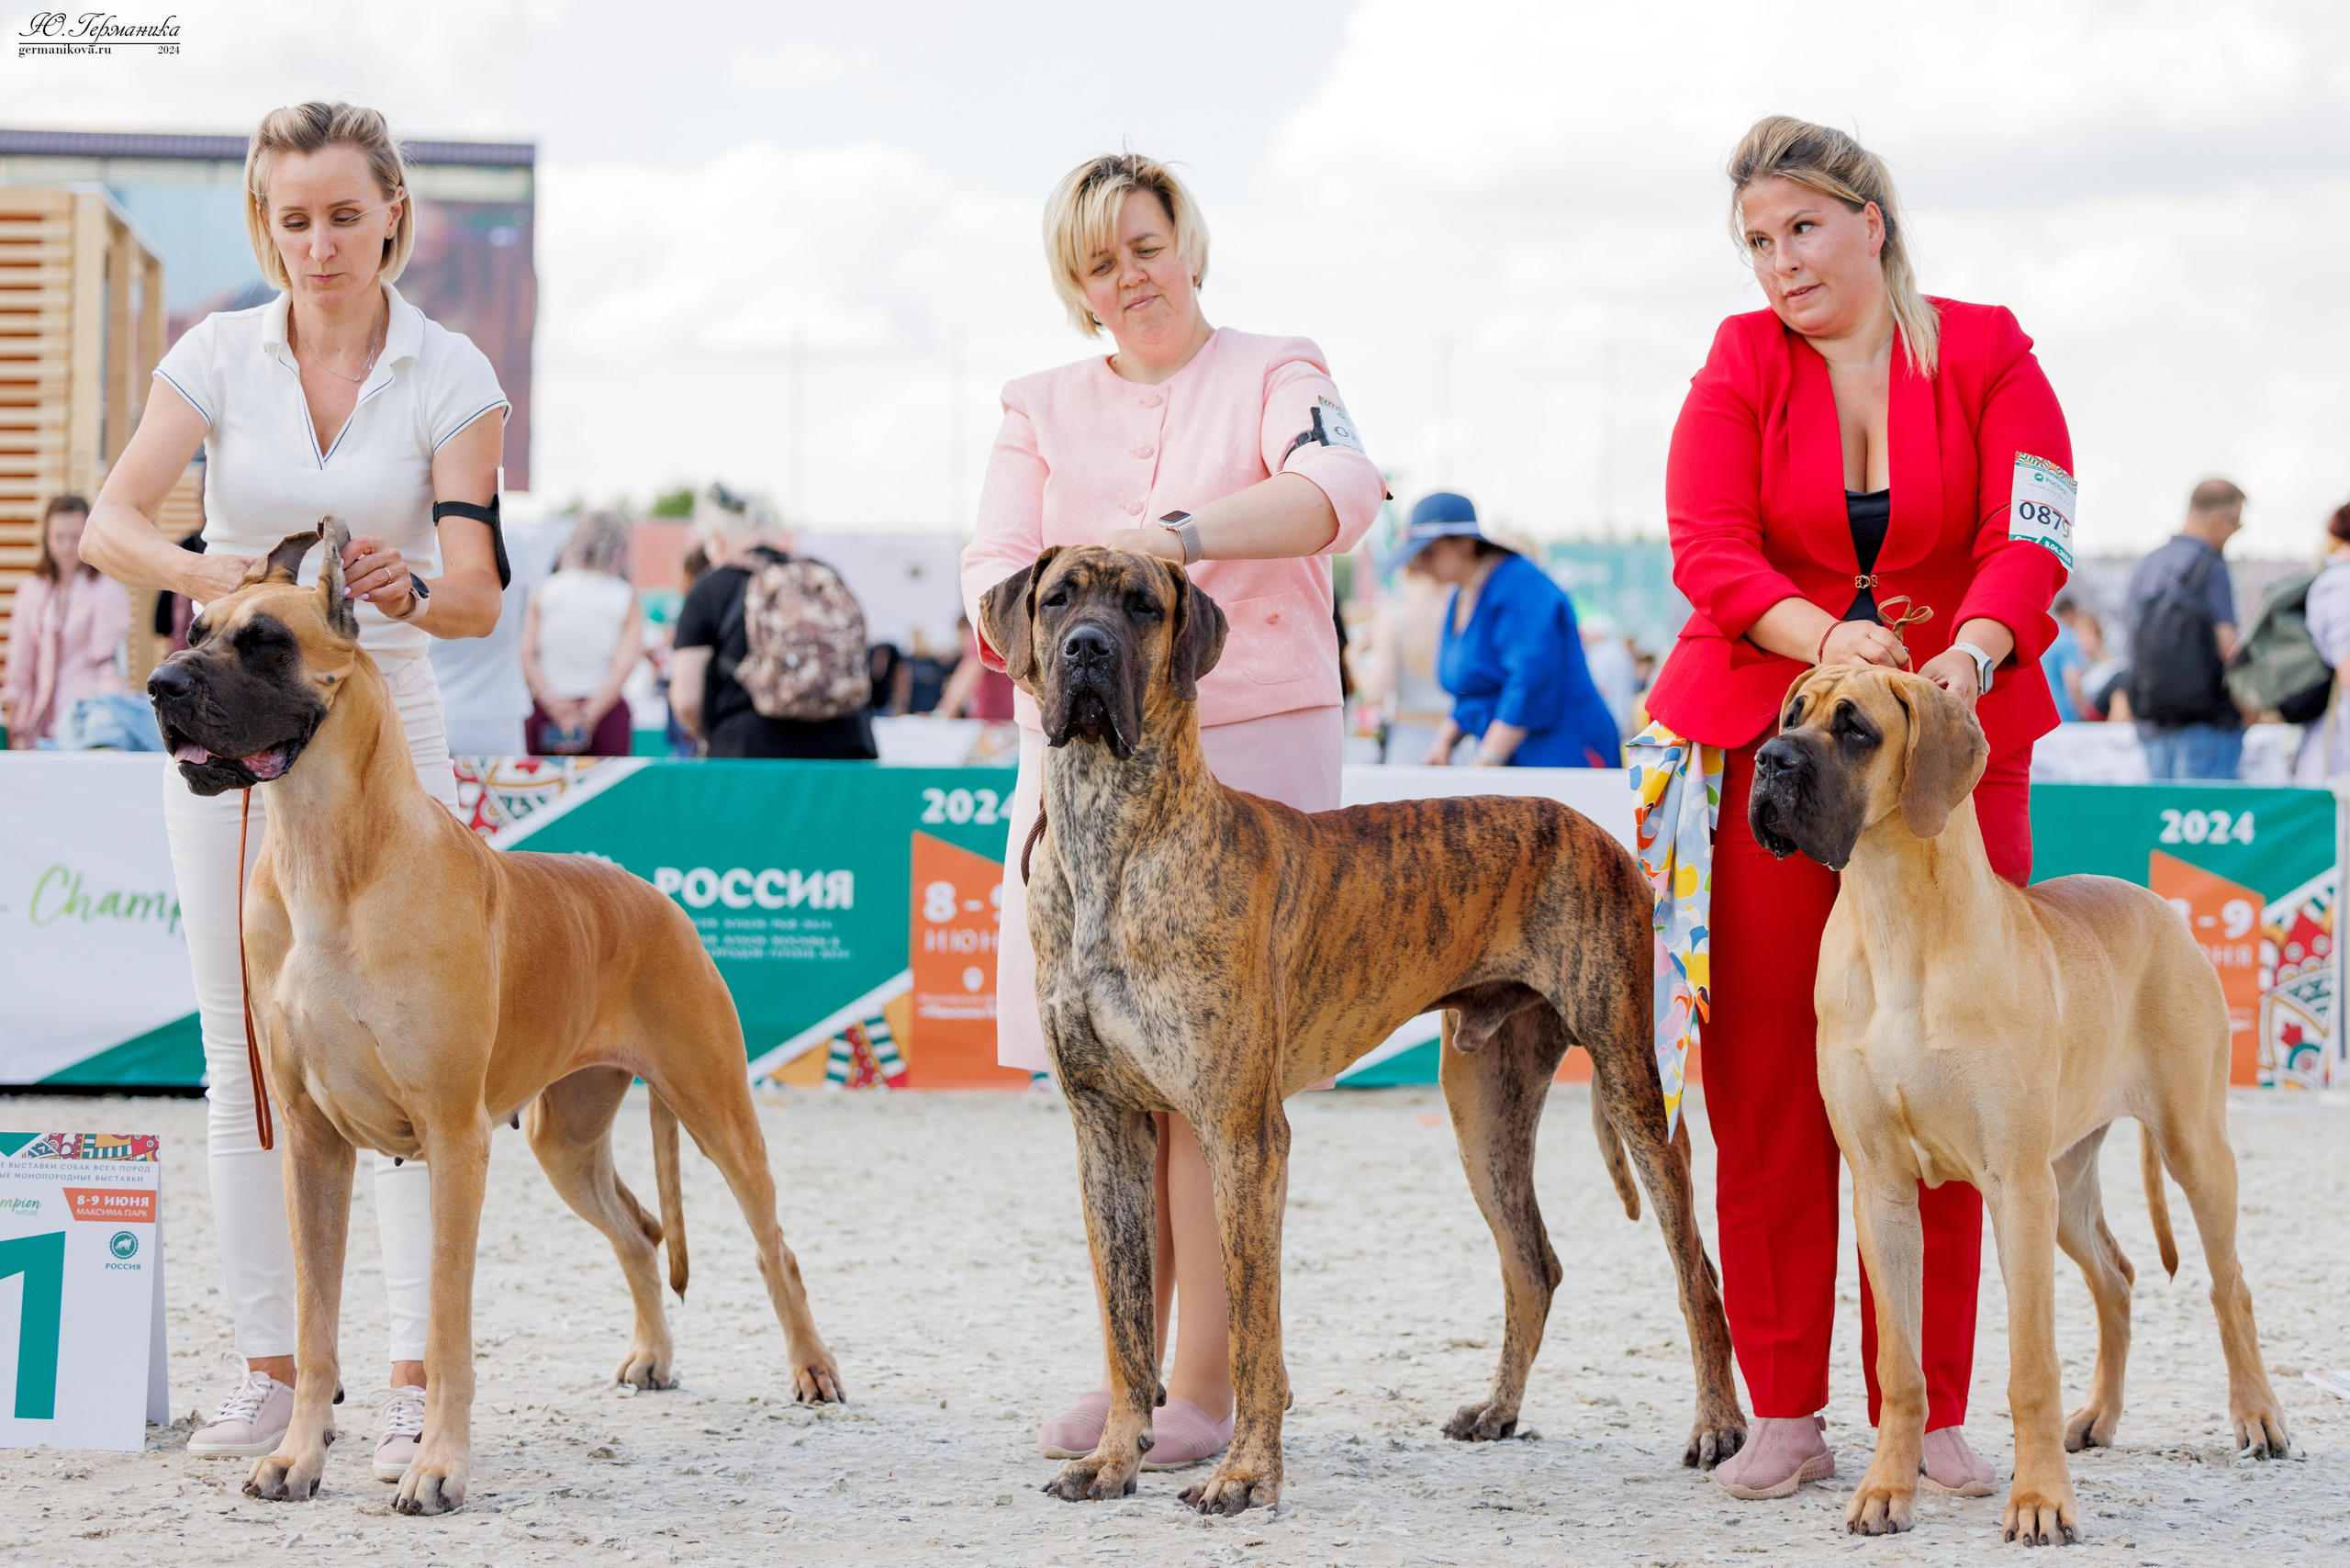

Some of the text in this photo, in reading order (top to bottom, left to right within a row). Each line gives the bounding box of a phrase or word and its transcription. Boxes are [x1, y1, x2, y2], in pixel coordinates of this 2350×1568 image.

[2019, 501, 2070, 539] 0879
[2044, 540, 2072, 565] 8.06.2024
[2159, 809, 2255, 845] 2024
[654, 867, 855, 910] РОССИЯ
[8, 1161, 57, 1170] ВЫСТАВКИ
[119, 1165, 151, 1173] ПОРОД
[14, 1172, 92, 1182] МОНОПОРОДНЫЕ
[76, 1194, 150, 1207] 8-9 ИЮНЯ
[76, 1207, 148, 1217] МАКСИМА ПАРК
[106, 1262, 141, 1271] РОССИЯ
